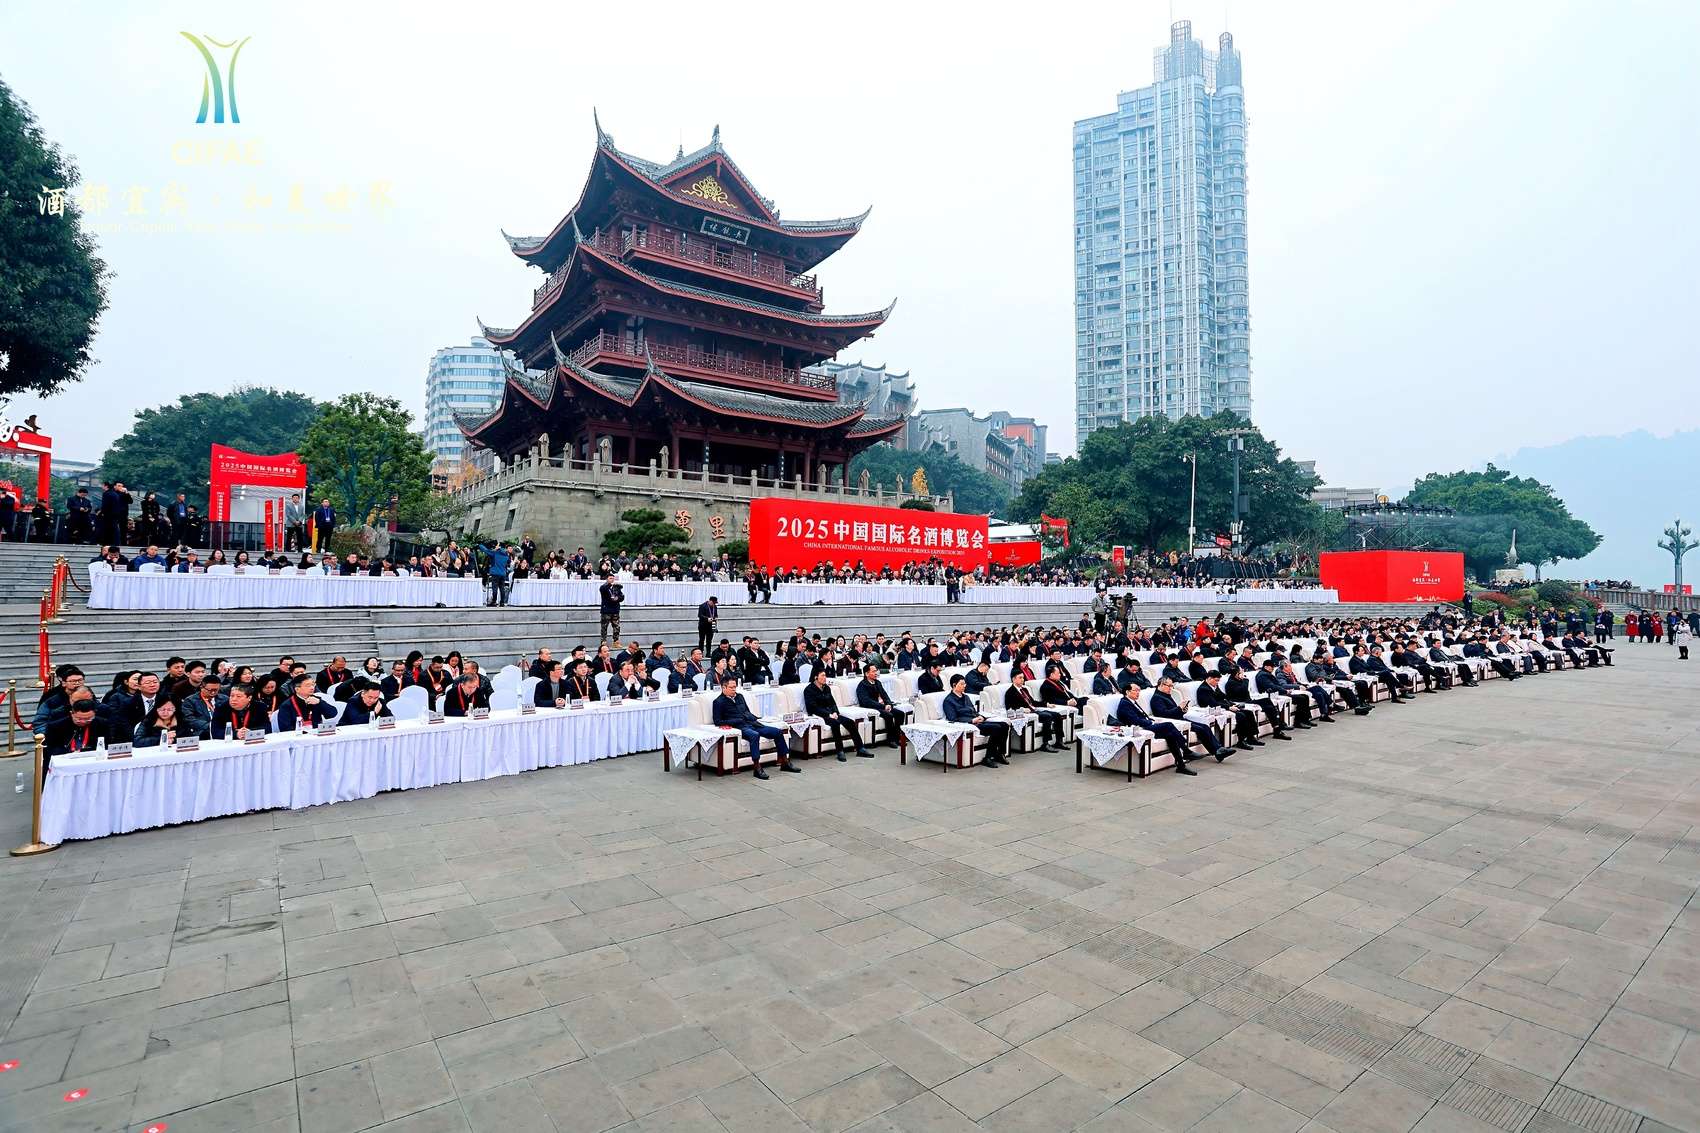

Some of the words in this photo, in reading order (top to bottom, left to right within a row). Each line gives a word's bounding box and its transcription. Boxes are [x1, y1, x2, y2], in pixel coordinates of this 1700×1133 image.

[776, 516, 985, 550] 2025中国国际名酒博览会
